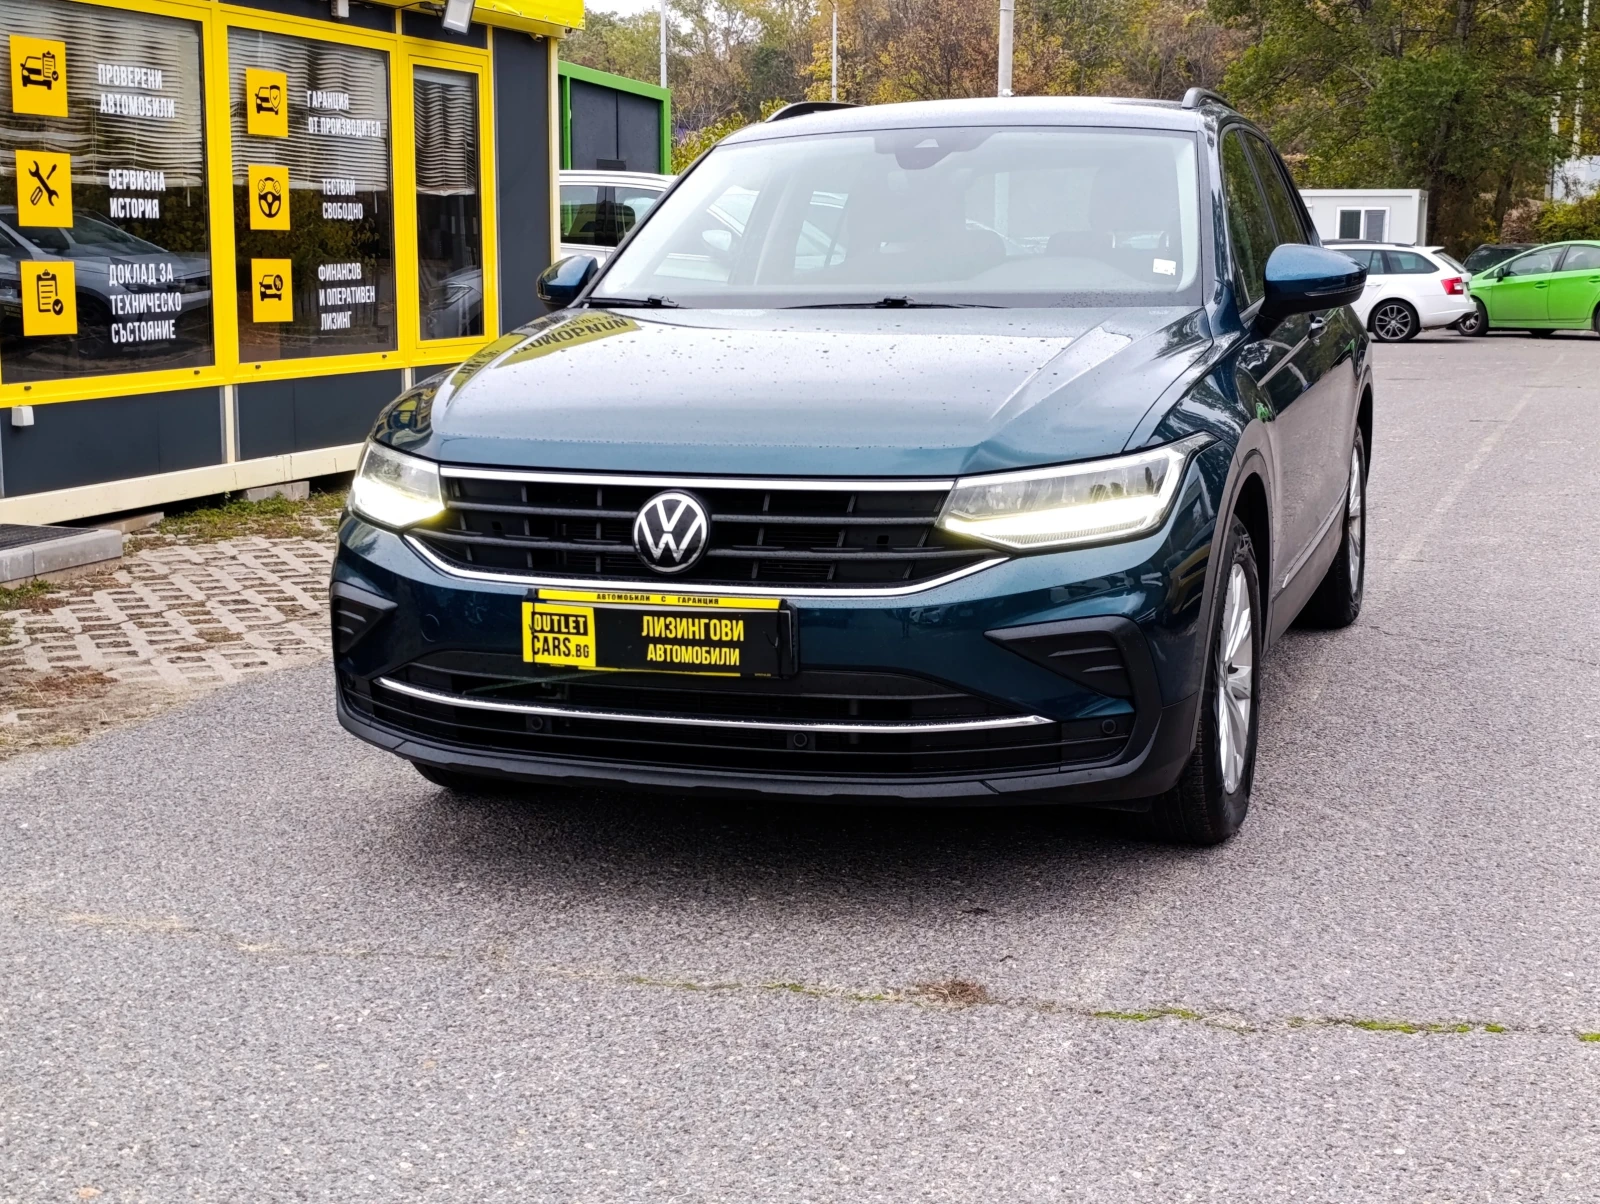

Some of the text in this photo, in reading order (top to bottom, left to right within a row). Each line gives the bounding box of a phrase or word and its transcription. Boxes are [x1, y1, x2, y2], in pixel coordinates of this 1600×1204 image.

[97, 63, 163, 89] ПРОВЕРЕНИ
[100, 93, 175, 118] АВТОМОБИЛИ
[307, 90, 349, 111] ГАРАНЦИЯ
[308, 116, 381, 138] ОТ ПРОИЗВОДИТЕЛ
[108, 168, 166, 191] СЕРВИЗНА
[322, 176, 356, 195] ТЕСТВАЙ
[109, 197, 159, 219] ИСТОРИЯ
[322, 202, 363, 221] СВОБОДНО
[109, 262, 174, 287] ДОКЛАД ЗА
[317, 262, 362, 281] ФИНАНСОВ
[109, 292, 182, 315] ТЕХНИЧЕСКО
[319, 285, 376, 306] И ОПЕРАТИВЕН
[111, 319, 176, 344] СЪСТОЯНИЕ
[320, 311, 352, 331] ЛИЗИНГ
[596, 593, 651, 602] АВТОМОБИЛИ
[677, 596, 720, 605] ГАРАНЦИЯ
[533, 614, 586, 634] OUTLET
[641, 615, 745, 642] ЛИЗИНГОВИ
[532, 635, 590, 659] CARS.BG
[646, 643, 740, 666] АВТОМОБИЛИ
